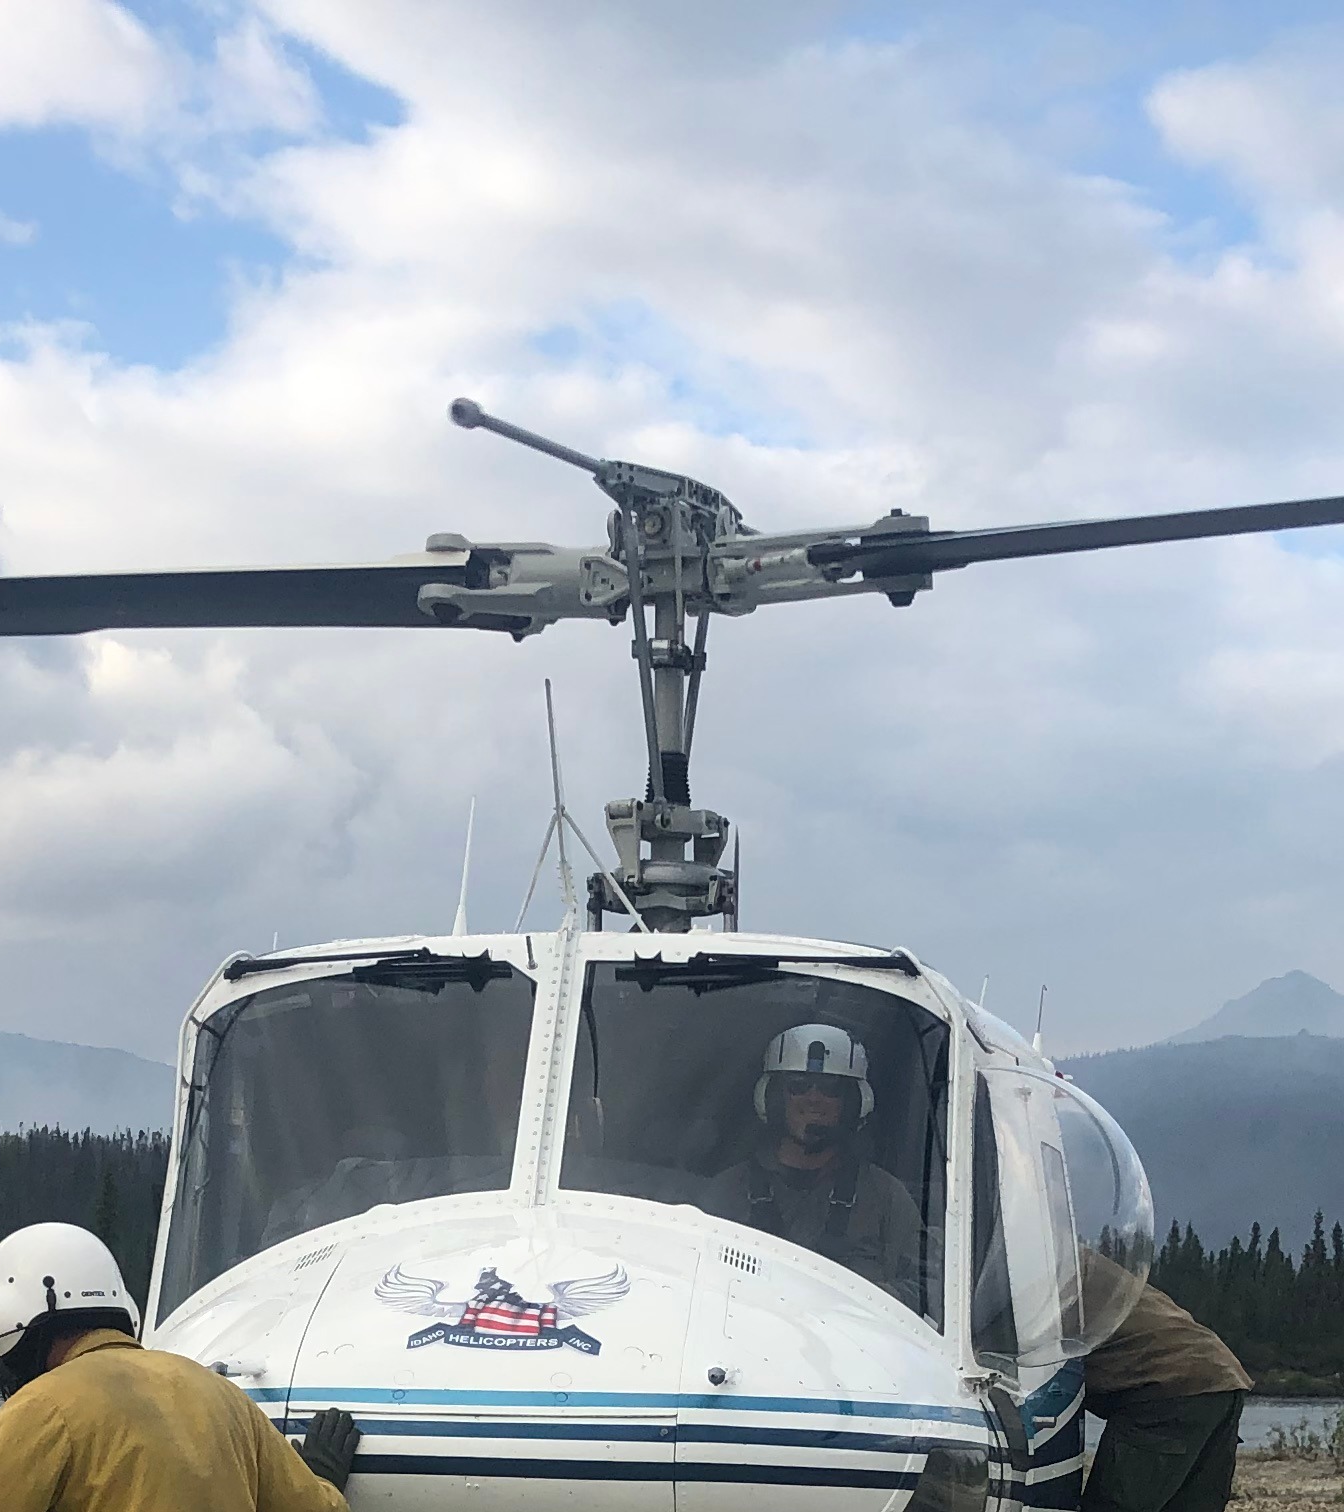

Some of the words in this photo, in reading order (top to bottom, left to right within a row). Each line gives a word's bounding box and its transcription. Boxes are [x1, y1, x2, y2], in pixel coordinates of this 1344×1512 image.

[410, 1329, 445, 1347] IDAHO
[448, 1333, 559, 1347] HELICOPTERS
[568, 1336, 592, 1351] INC
